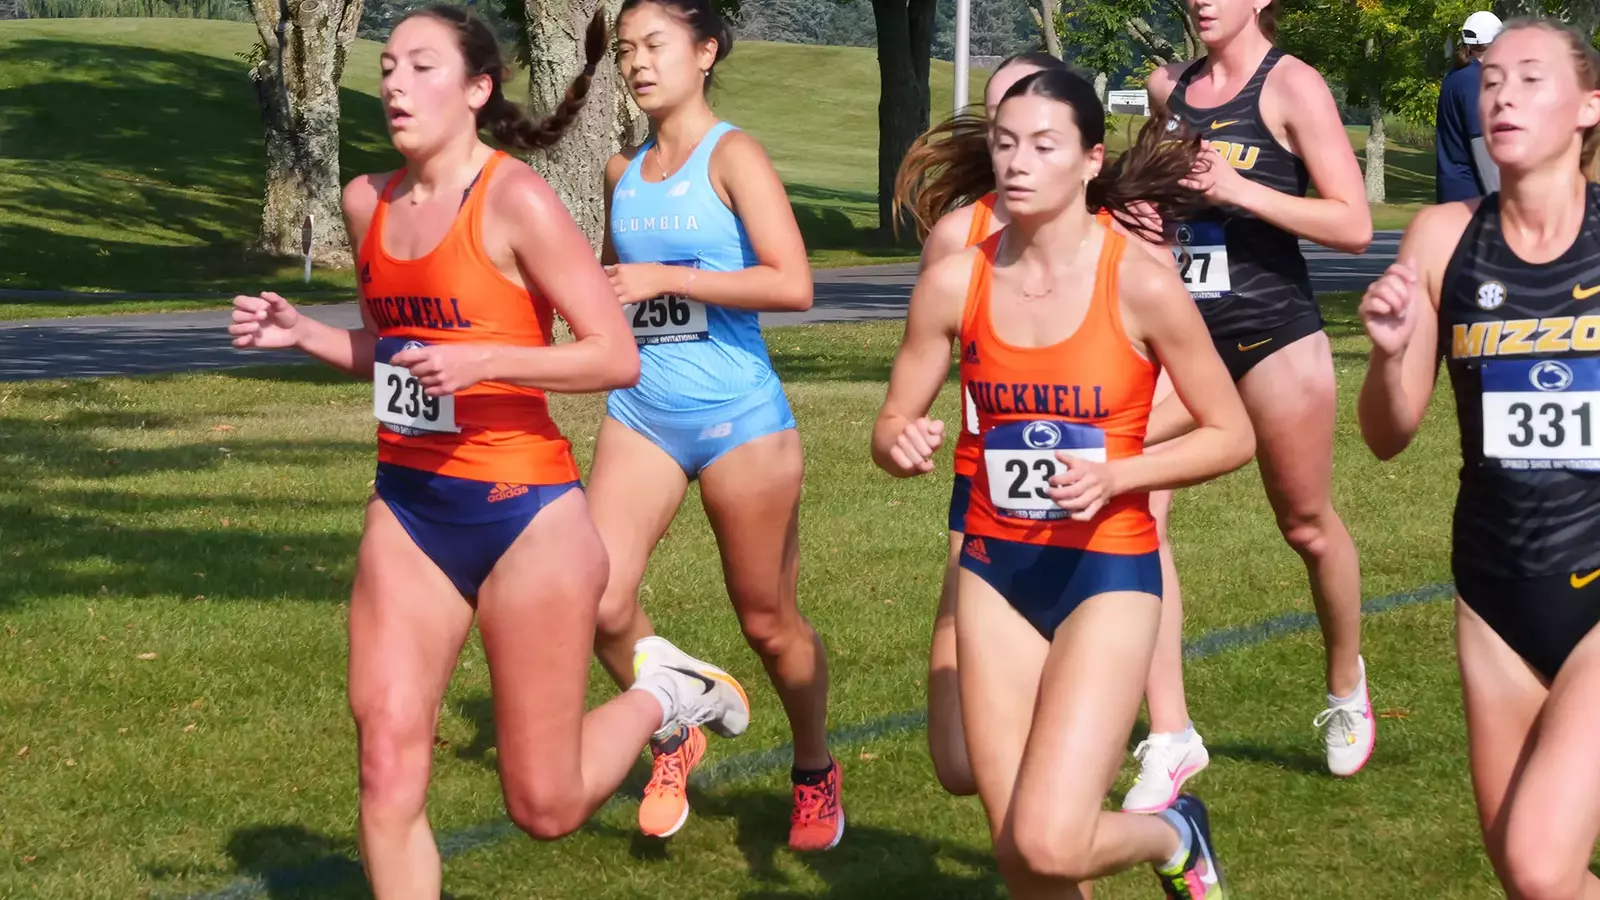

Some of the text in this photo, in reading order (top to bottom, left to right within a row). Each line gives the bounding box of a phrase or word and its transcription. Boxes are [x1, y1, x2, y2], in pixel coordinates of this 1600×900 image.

[1173, 252, 1212, 283] 27
[633, 293, 691, 328] 256
[387, 373, 440, 422] 239
[1507, 402, 1592, 448] 331
[487, 485, 529, 502] adidas
[1005, 459, 1058, 499] 23
